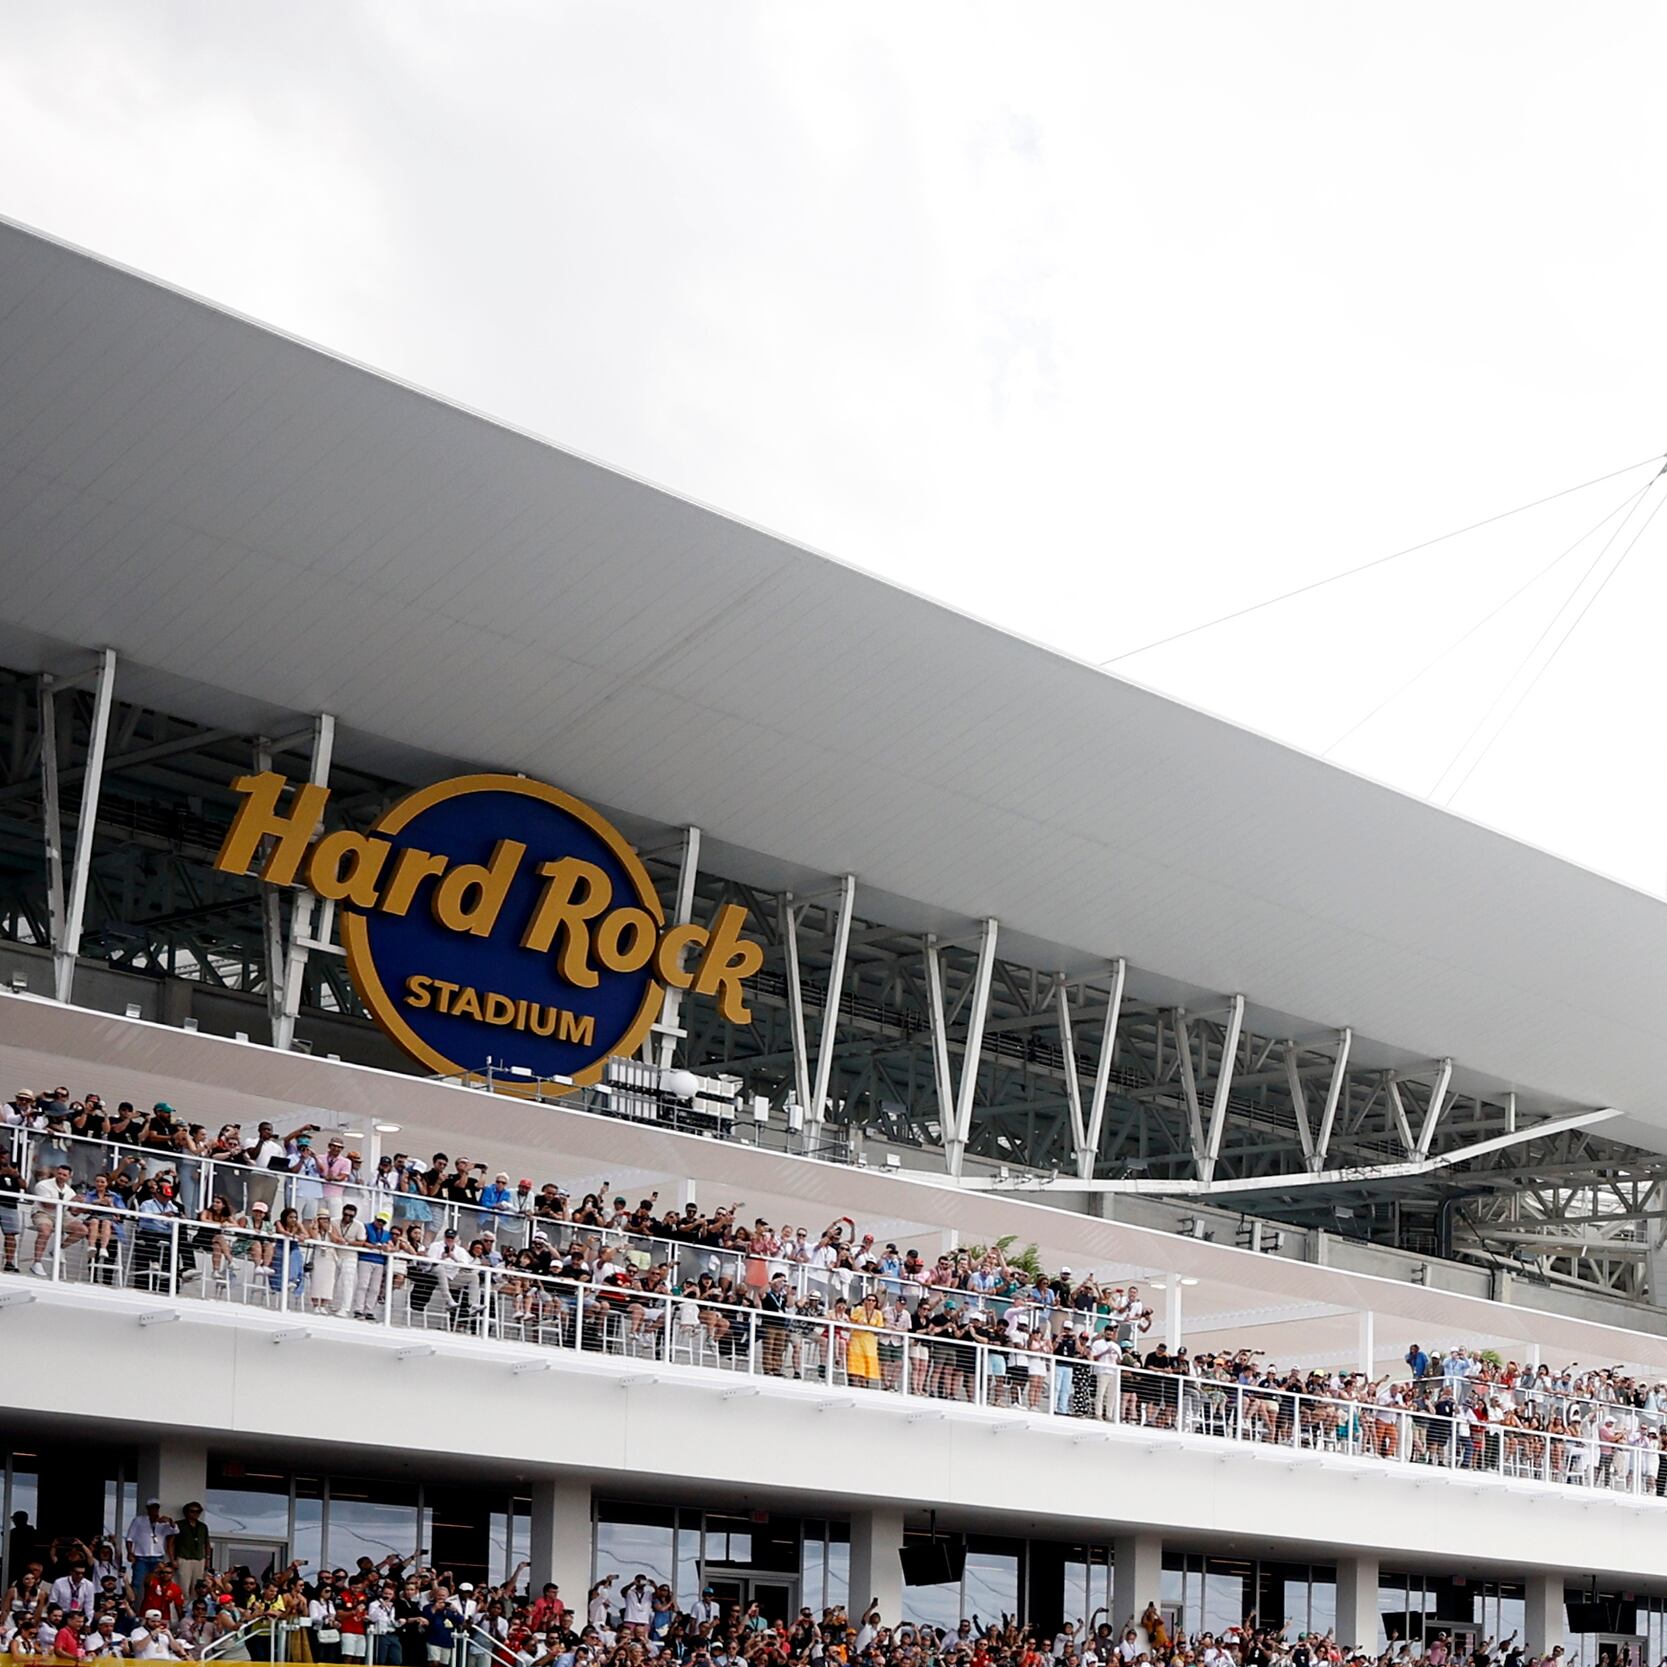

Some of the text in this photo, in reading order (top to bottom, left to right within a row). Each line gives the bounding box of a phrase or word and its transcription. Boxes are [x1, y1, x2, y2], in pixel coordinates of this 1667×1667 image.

[214, 771, 764, 1024] Hard Rock
[406, 973, 595, 1047] STADIUM
